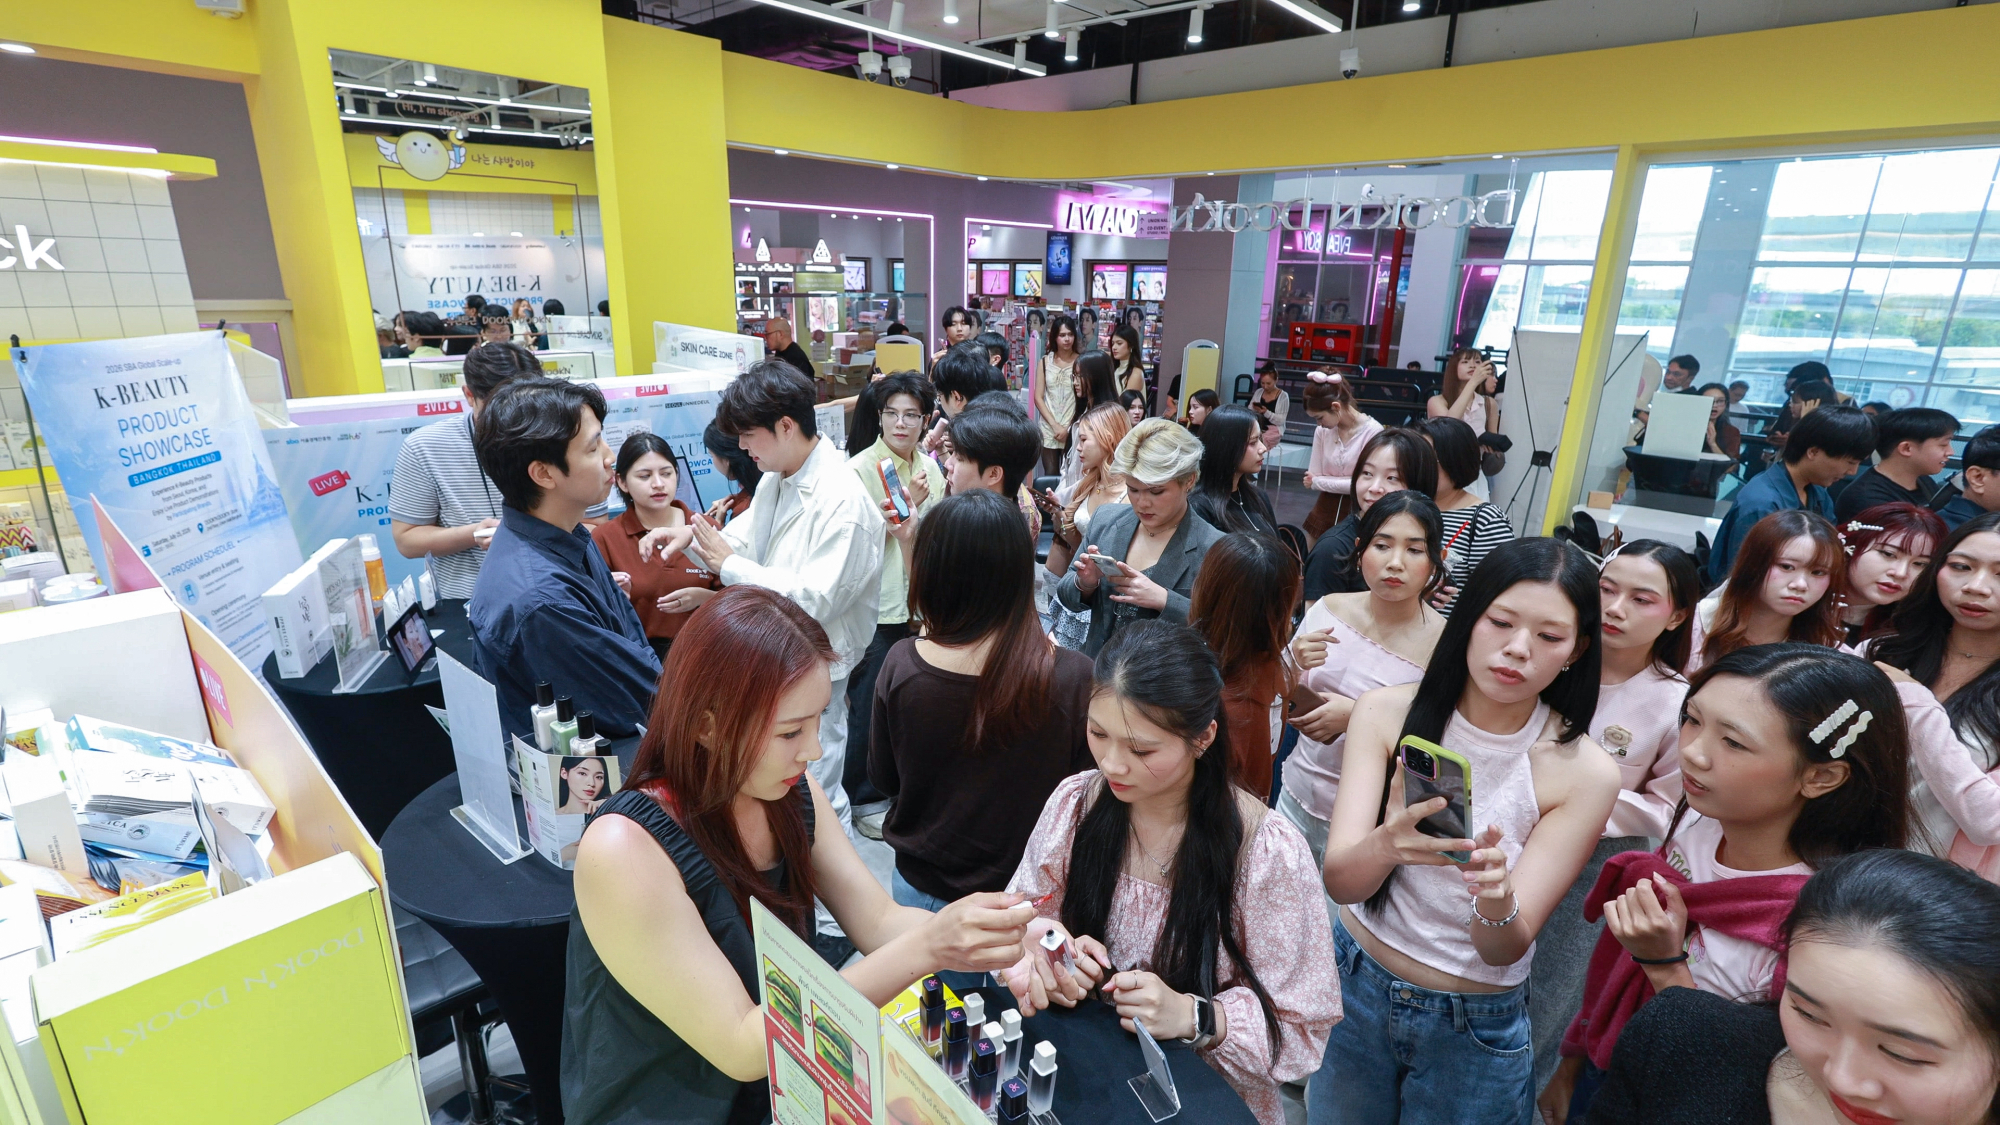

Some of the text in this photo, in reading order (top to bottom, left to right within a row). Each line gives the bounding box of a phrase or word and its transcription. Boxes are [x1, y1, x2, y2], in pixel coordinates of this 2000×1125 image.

[471, 154, 534, 168] 나는 샤방이야
[681, 342, 733, 359] SKIN CARE ZONE
[105, 358, 182, 374] 2026 SBA Global Scale-up
[93, 374, 189, 410] K-BEAUTY
[117, 404, 199, 438] PRODUCT
[118, 428, 212, 467] SHOWCASE
[133, 453, 216, 484] BANGKOK THAILAND
[314, 476, 341, 492] LIVE
[171, 554, 203, 576] PROGRAM
